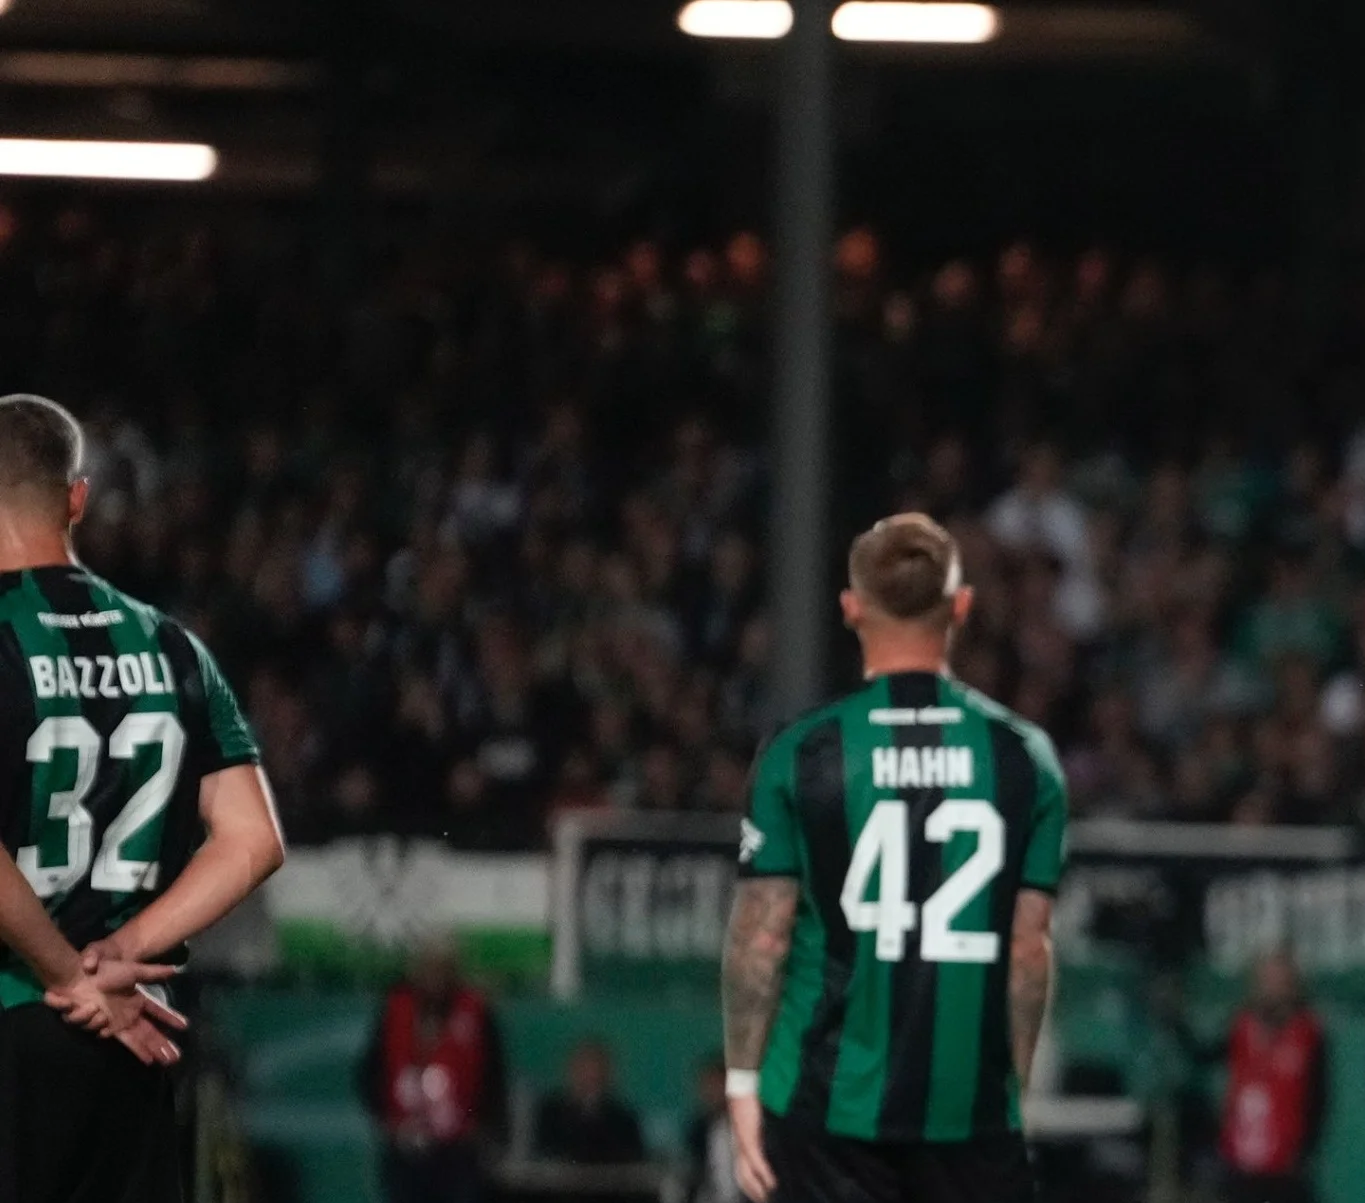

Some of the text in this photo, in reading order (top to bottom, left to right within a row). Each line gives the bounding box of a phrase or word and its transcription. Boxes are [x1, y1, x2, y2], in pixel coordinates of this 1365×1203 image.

[29, 652, 176, 698] BAZZOLI
[16, 712, 188, 898] 32
[872, 746, 974, 788] HAHN
[839, 799, 1006, 963] 42
